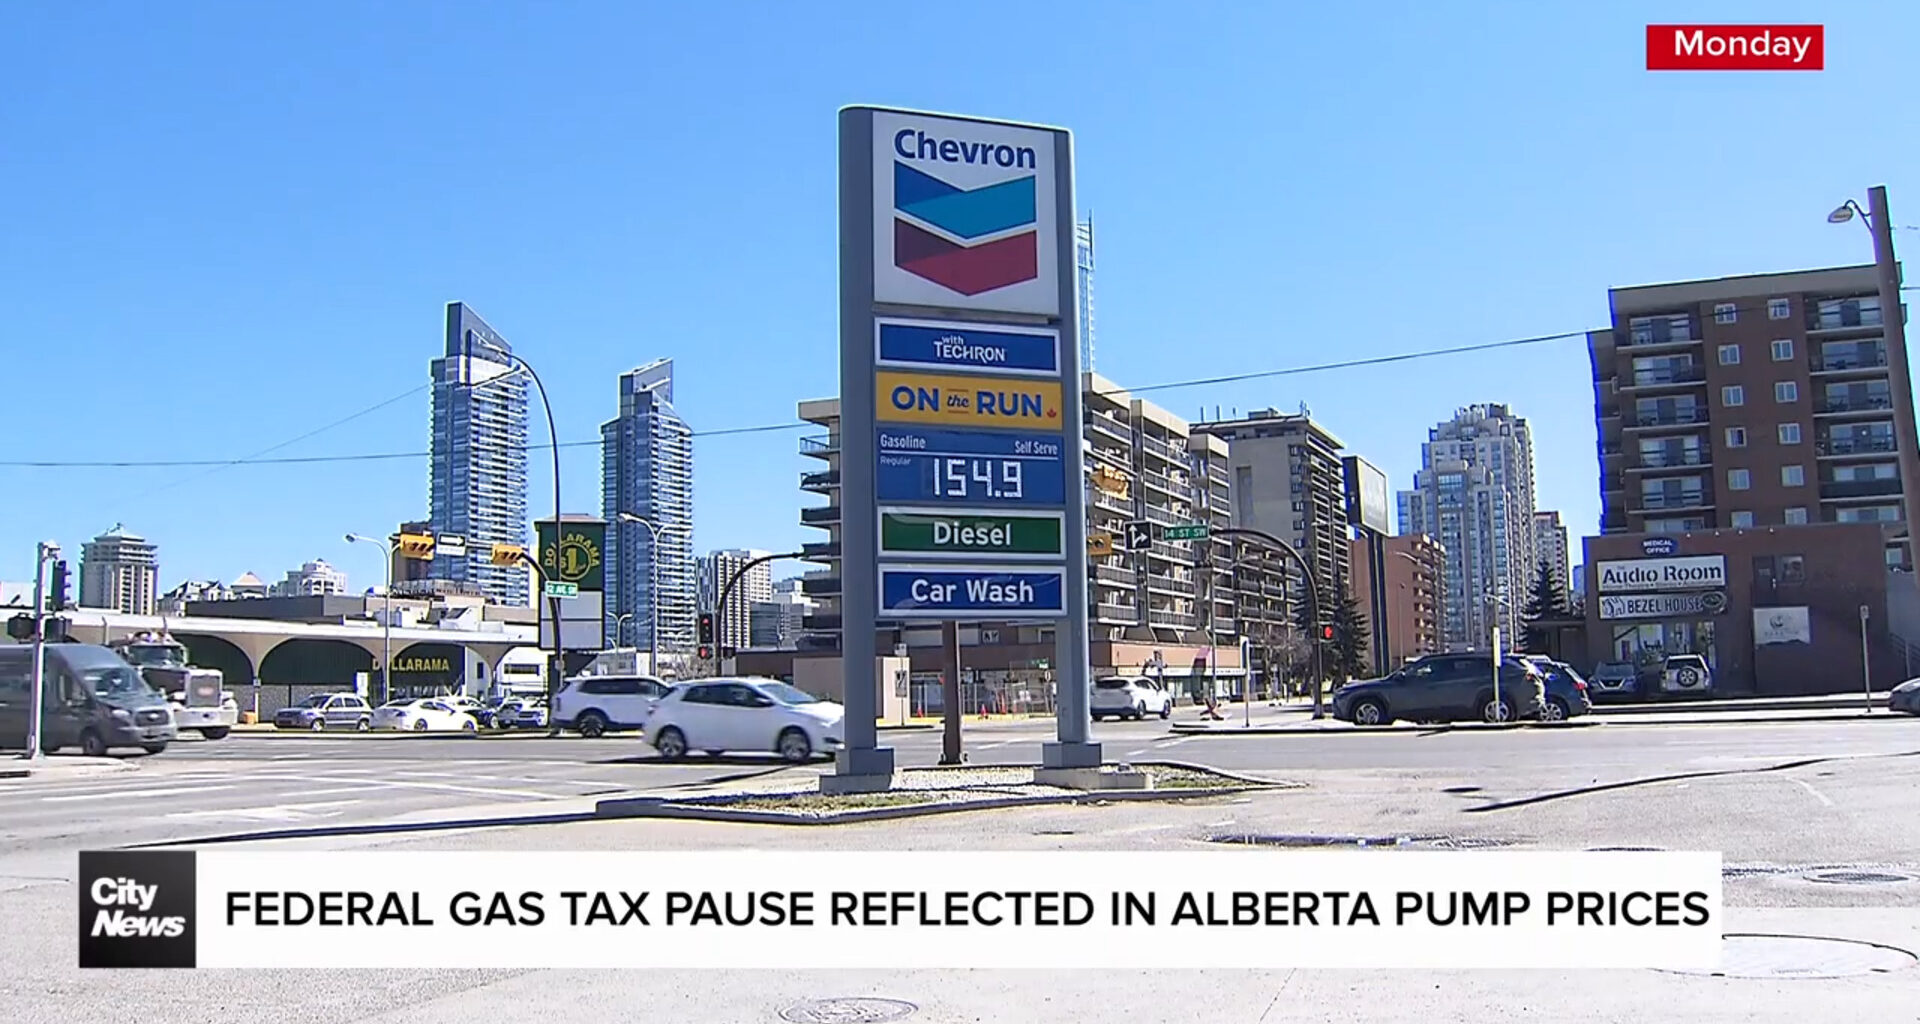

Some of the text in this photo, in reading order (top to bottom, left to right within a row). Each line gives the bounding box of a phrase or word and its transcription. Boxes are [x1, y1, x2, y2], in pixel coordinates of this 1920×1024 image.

[894, 129, 1036, 169] Chevron
[942, 335, 964, 345] with
[934, 341, 1005, 363] TECHRON
[892, 386, 1042, 417] ON the RUN
[880, 434, 1058, 455] Gasoline Self Serve
[880, 456, 911, 466] Regular
[934, 458, 1022, 498] 154.9
[934, 521, 1011, 546] Diesel
[1165, 527, 1207, 538] 14 ST SW
[1643, 539, 1672, 547] MEDICAL
[1646, 546, 1670, 554] OFFICE
[1603, 565, 1722, 584] Audio Room
[911, 579, 1034, 602] Car Wash
[1627, 596, 1702, 614] BEZEL HOUSE
[372, 657, 450, 672] DLLARAMA
